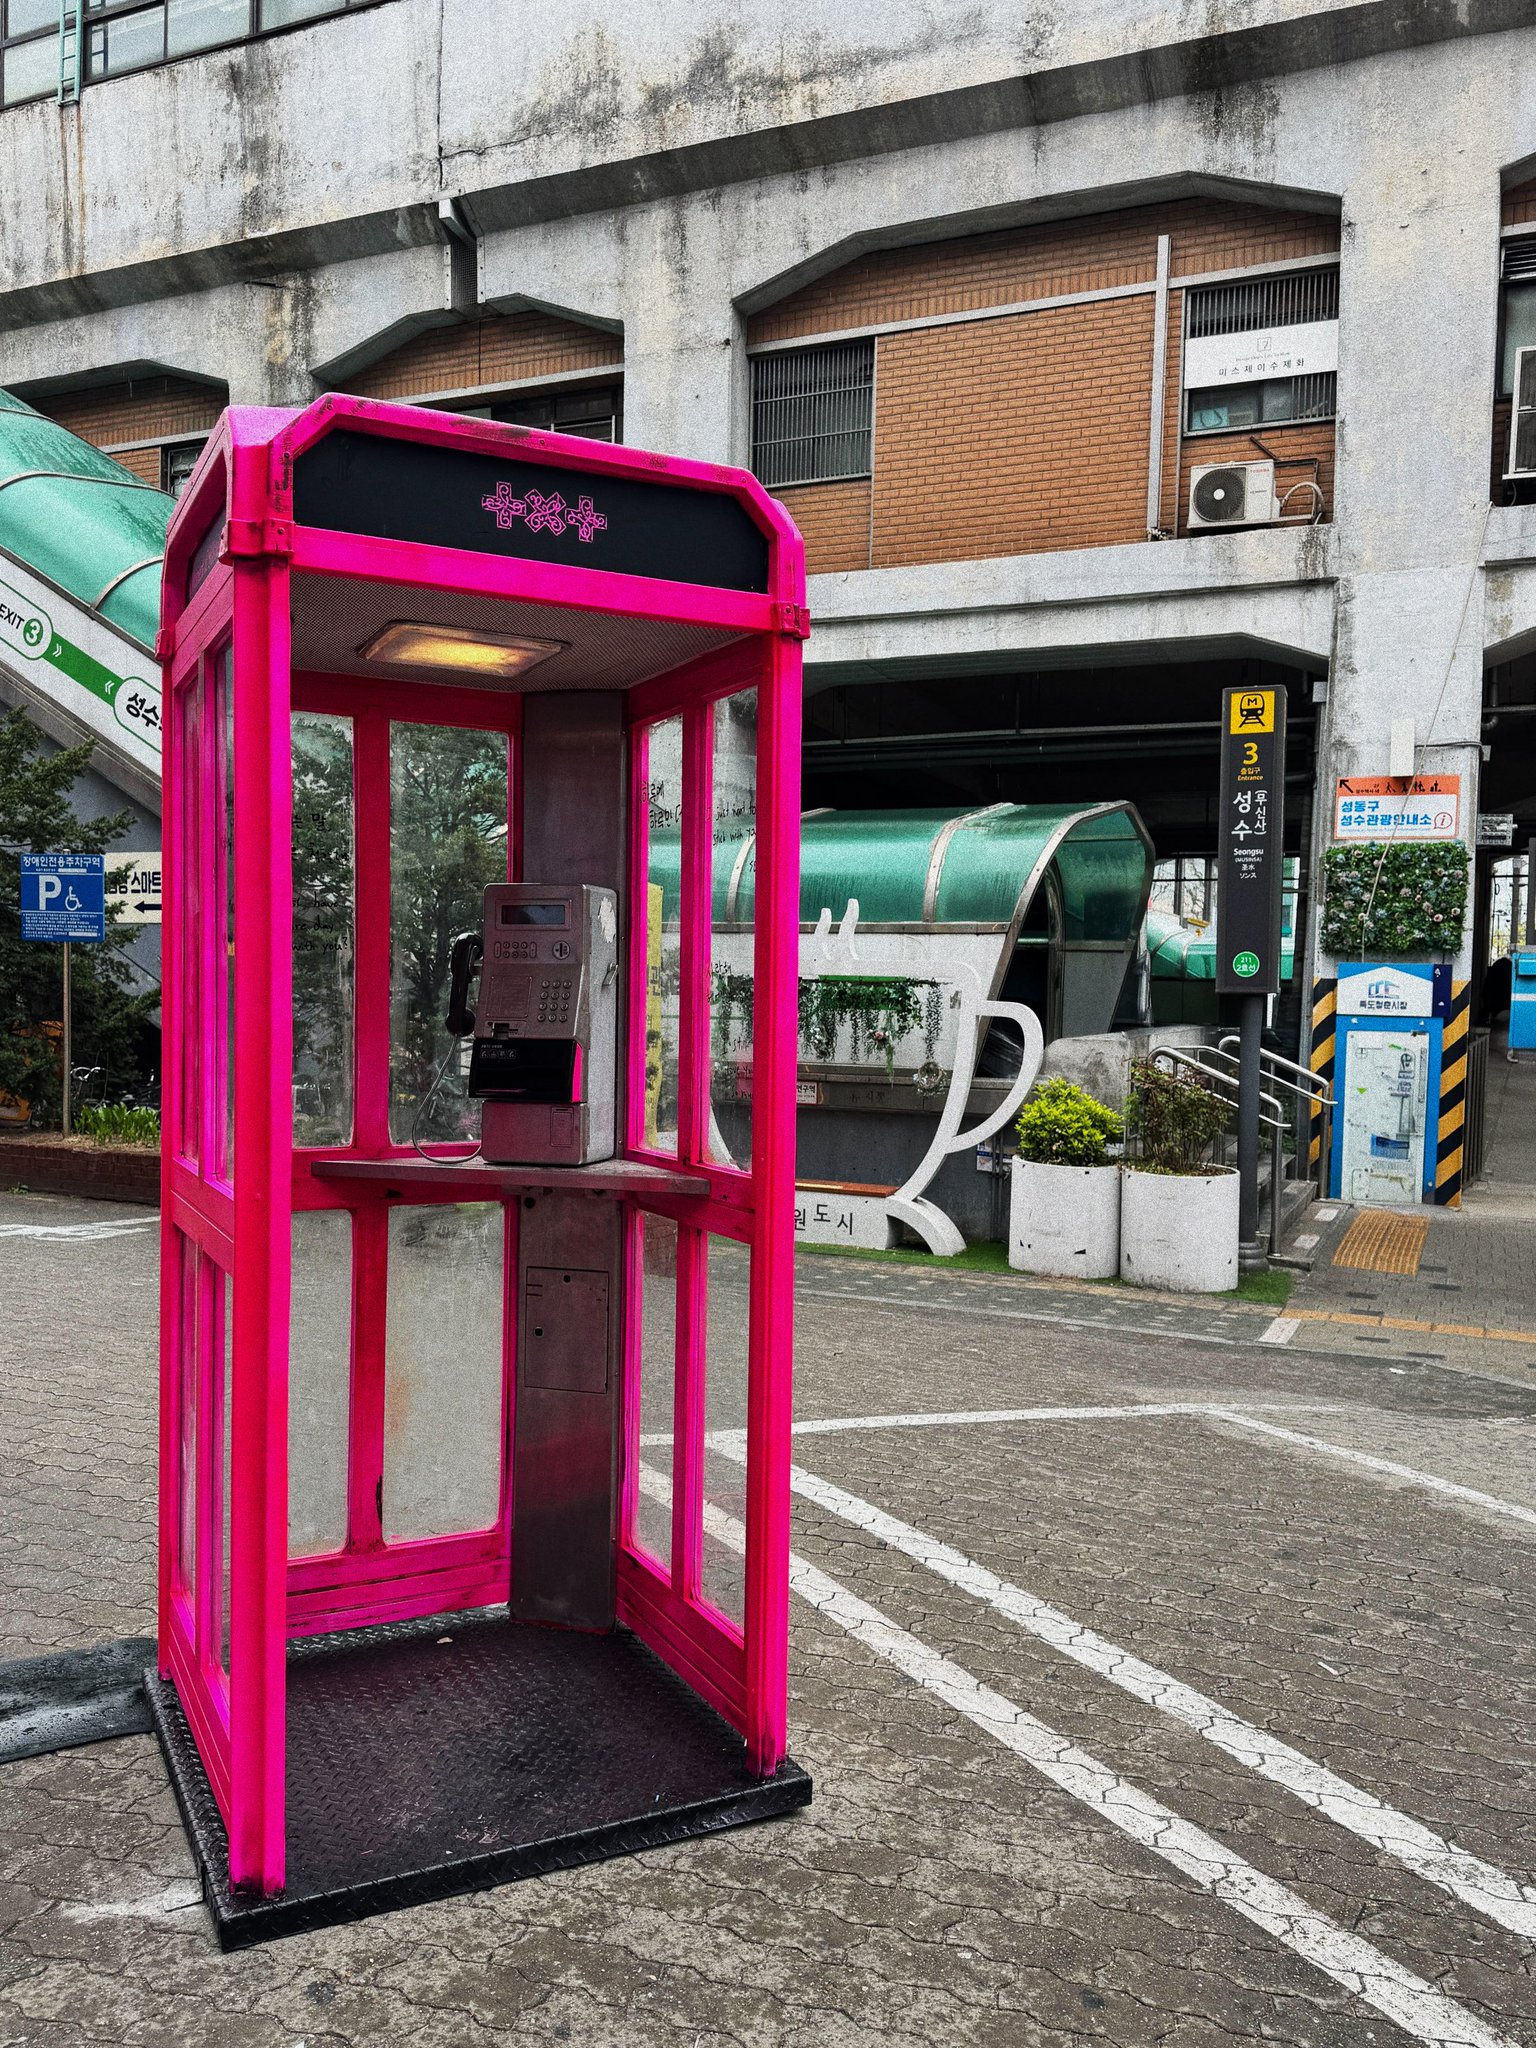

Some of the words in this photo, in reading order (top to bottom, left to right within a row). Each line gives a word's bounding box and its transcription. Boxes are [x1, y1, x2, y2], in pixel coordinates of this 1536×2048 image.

[0, 603, 25, 629] EXIT
[26, 621, 40, 643] 3
[126, 692, 162, 731] 성수
[1242, 742, 1259, 765] 3
[1231, 790, 1253, 841] 성수
[1253, 789, 1268, 836] (무신사)
[1341, 800, 1380, 813] 성동구
[1340, 813, 1432, 827] 성수관광안내소
[23, 855, 101, 868] 장애인전용주차구역
[1233, 847, 1264, 857] Seongsu
[39, 875, 62, 911] P
[130, 871, 162, 895] 스마트
